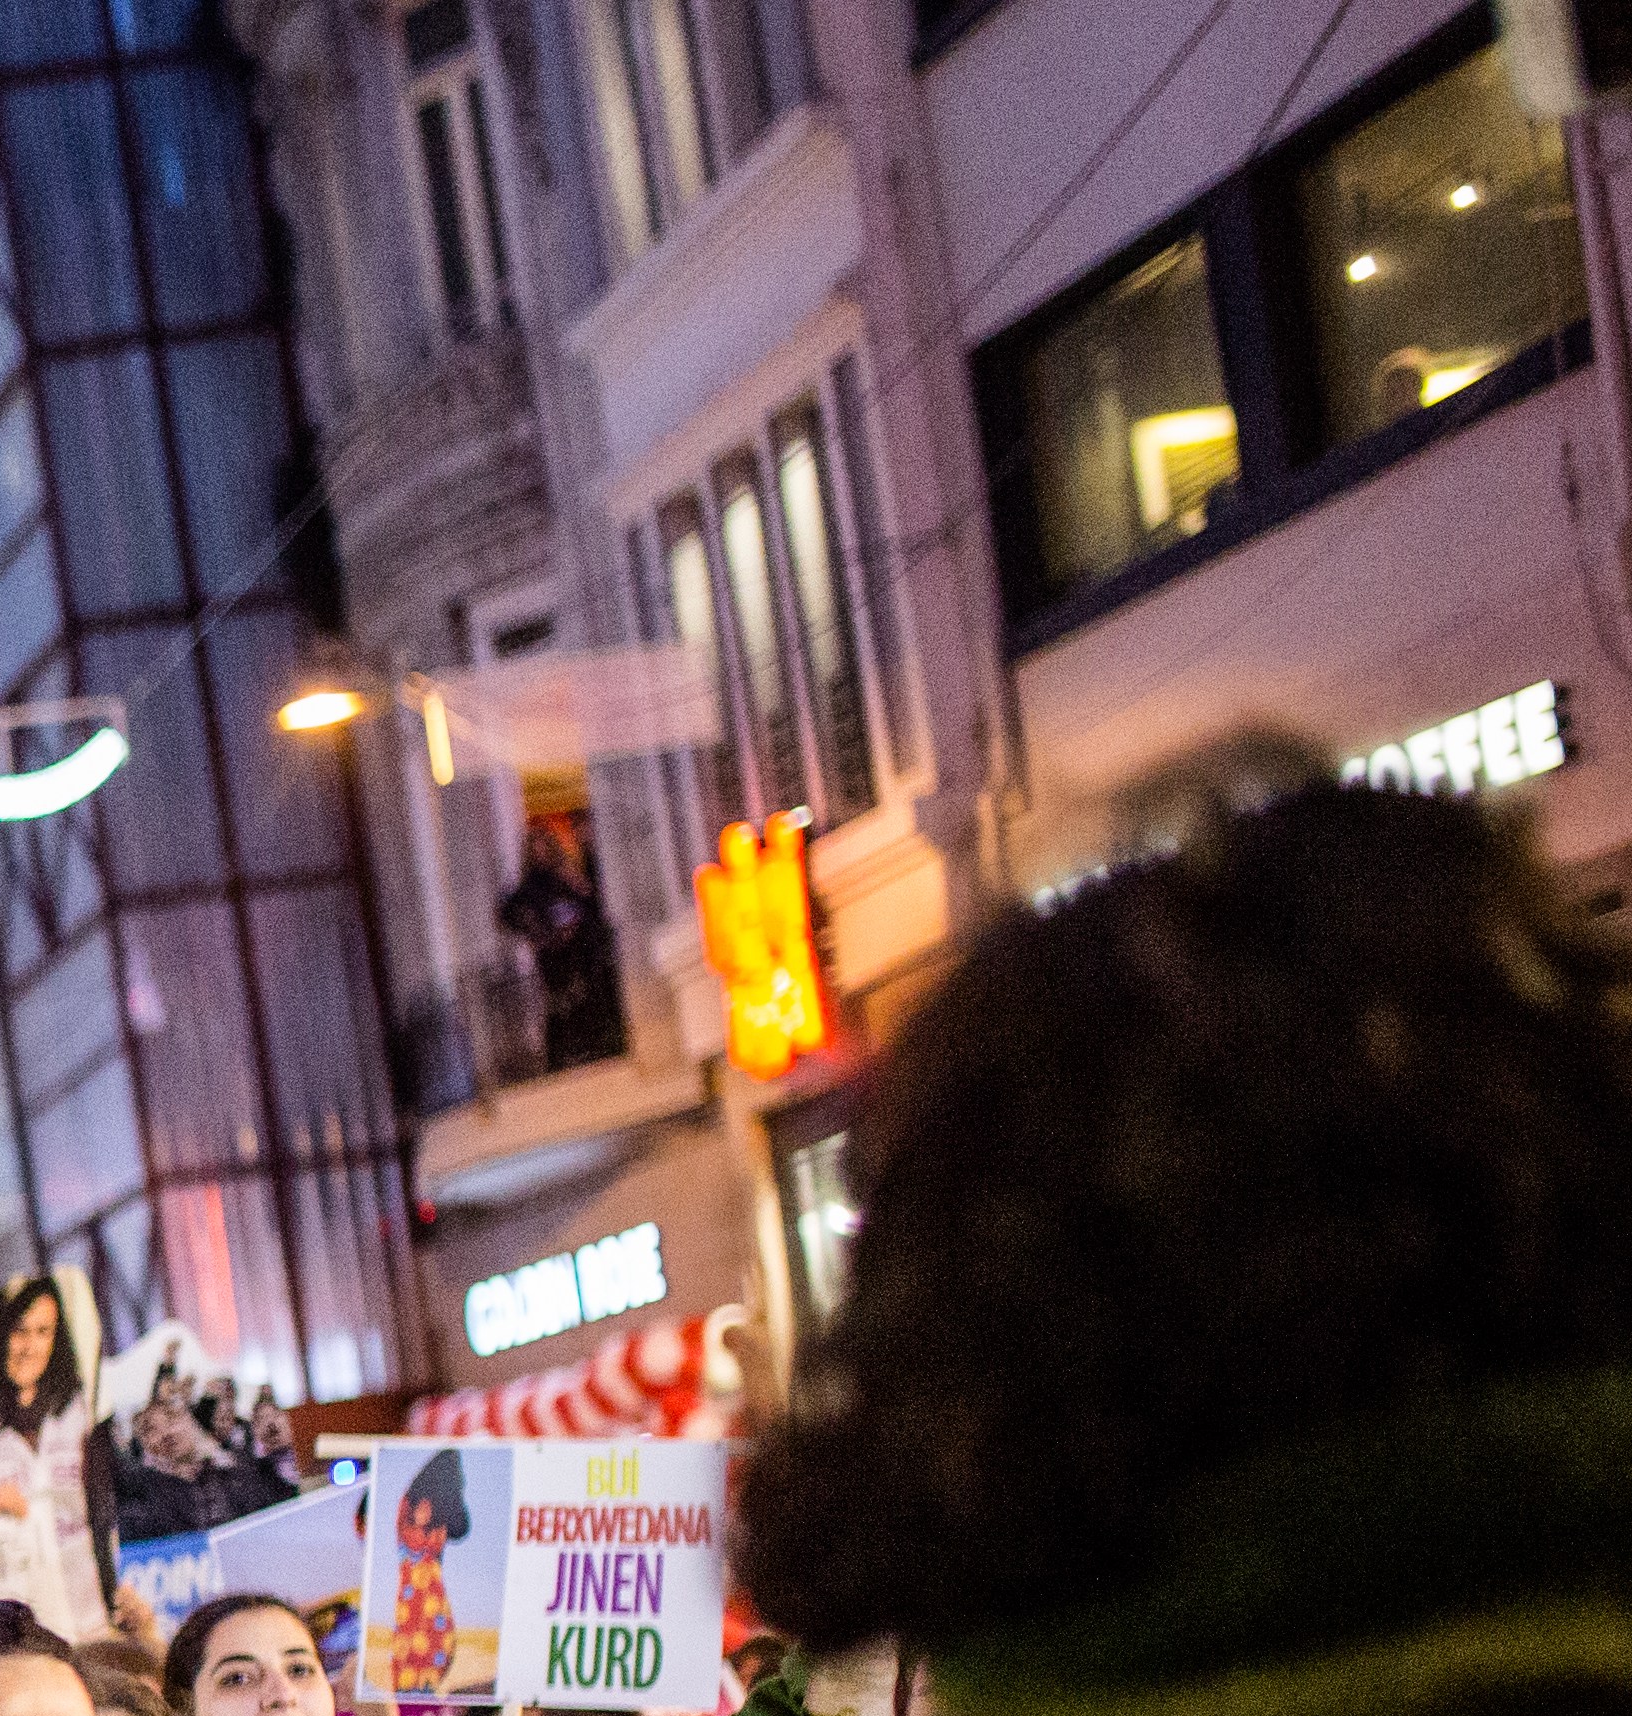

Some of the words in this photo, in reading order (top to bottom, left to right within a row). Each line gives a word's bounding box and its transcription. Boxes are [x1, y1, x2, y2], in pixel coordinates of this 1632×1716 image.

[516, 1505, 712, 1545] BERXWEDANA
[546, 1551, 664, 1614] JINEN
[546, 1624, 664, 1689] KURD
